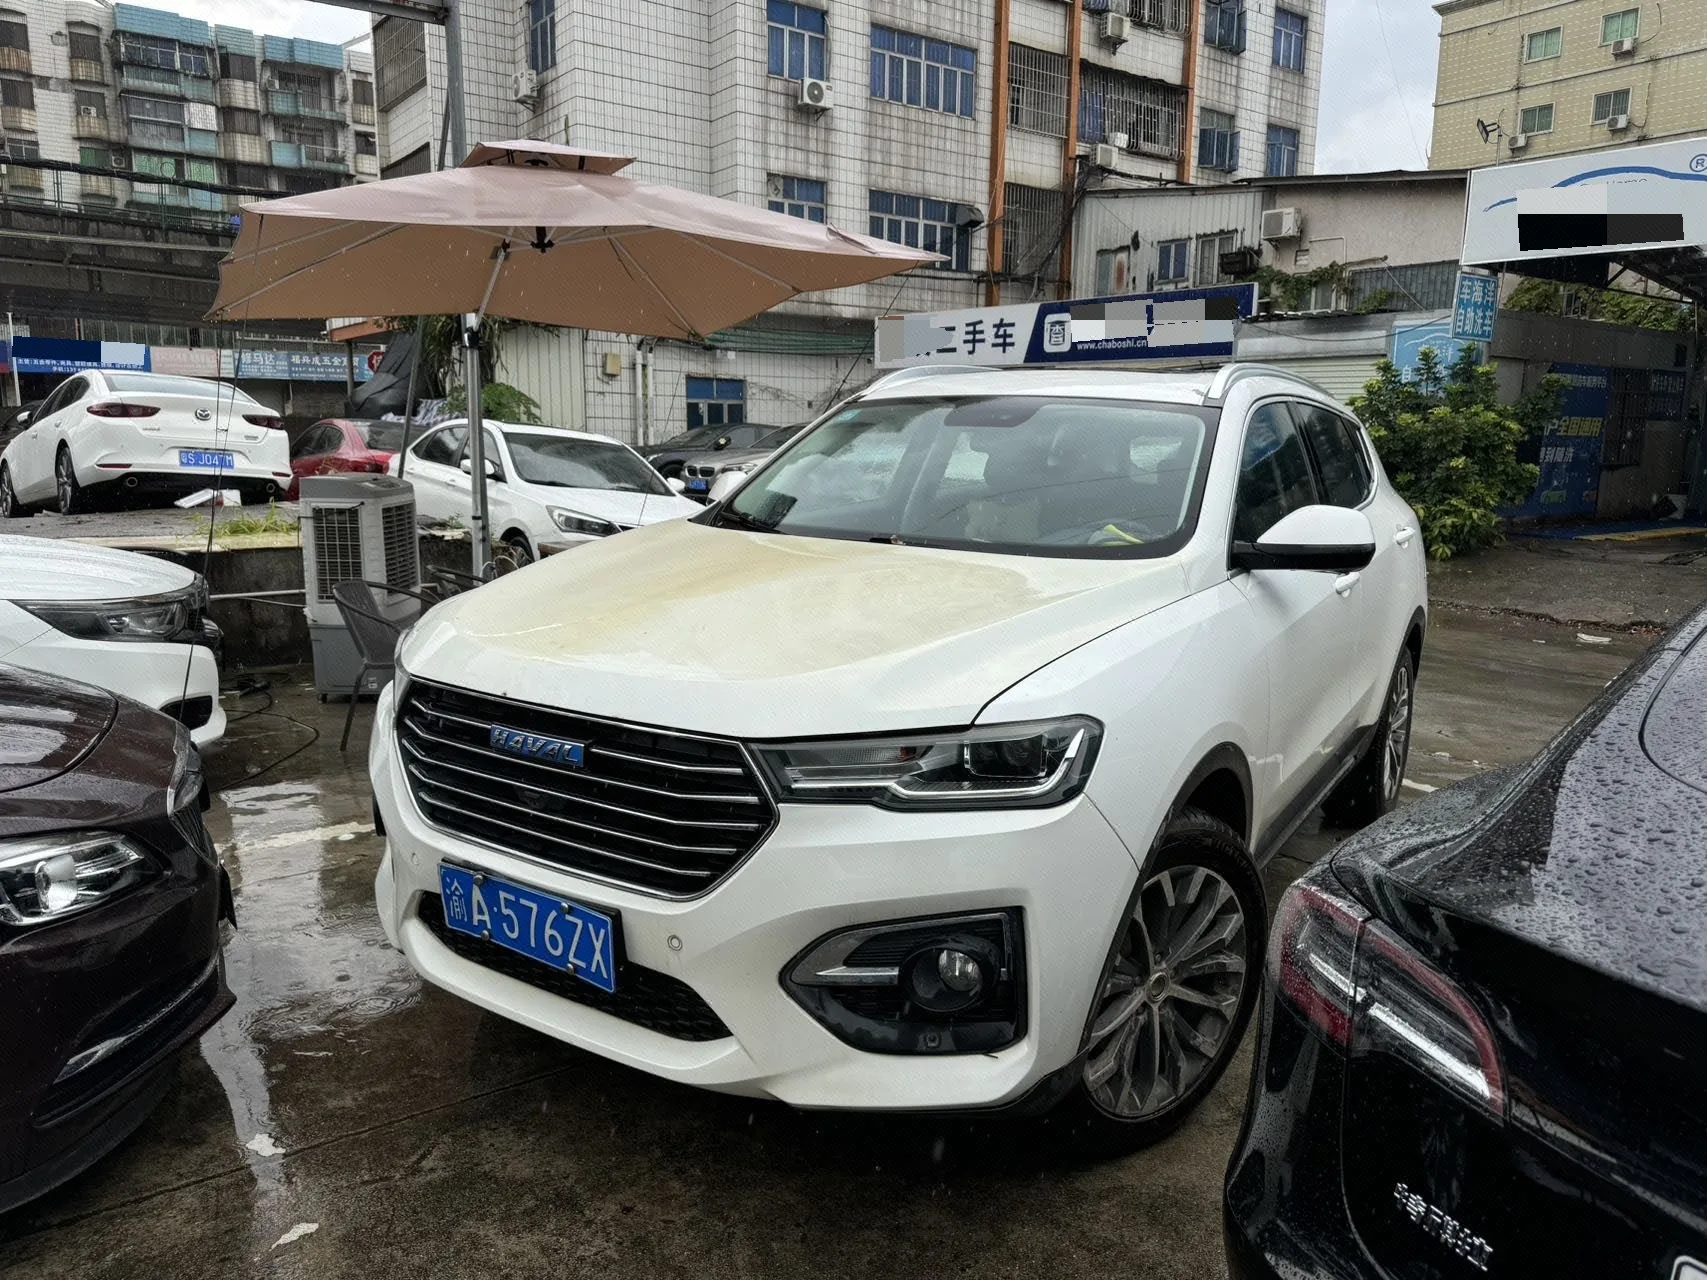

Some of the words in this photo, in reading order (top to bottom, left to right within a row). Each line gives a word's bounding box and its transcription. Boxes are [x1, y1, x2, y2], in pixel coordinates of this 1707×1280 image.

[1456, 306, 1494, 336] 自助洗车
[492, 728, 579, 762] HAVAL
